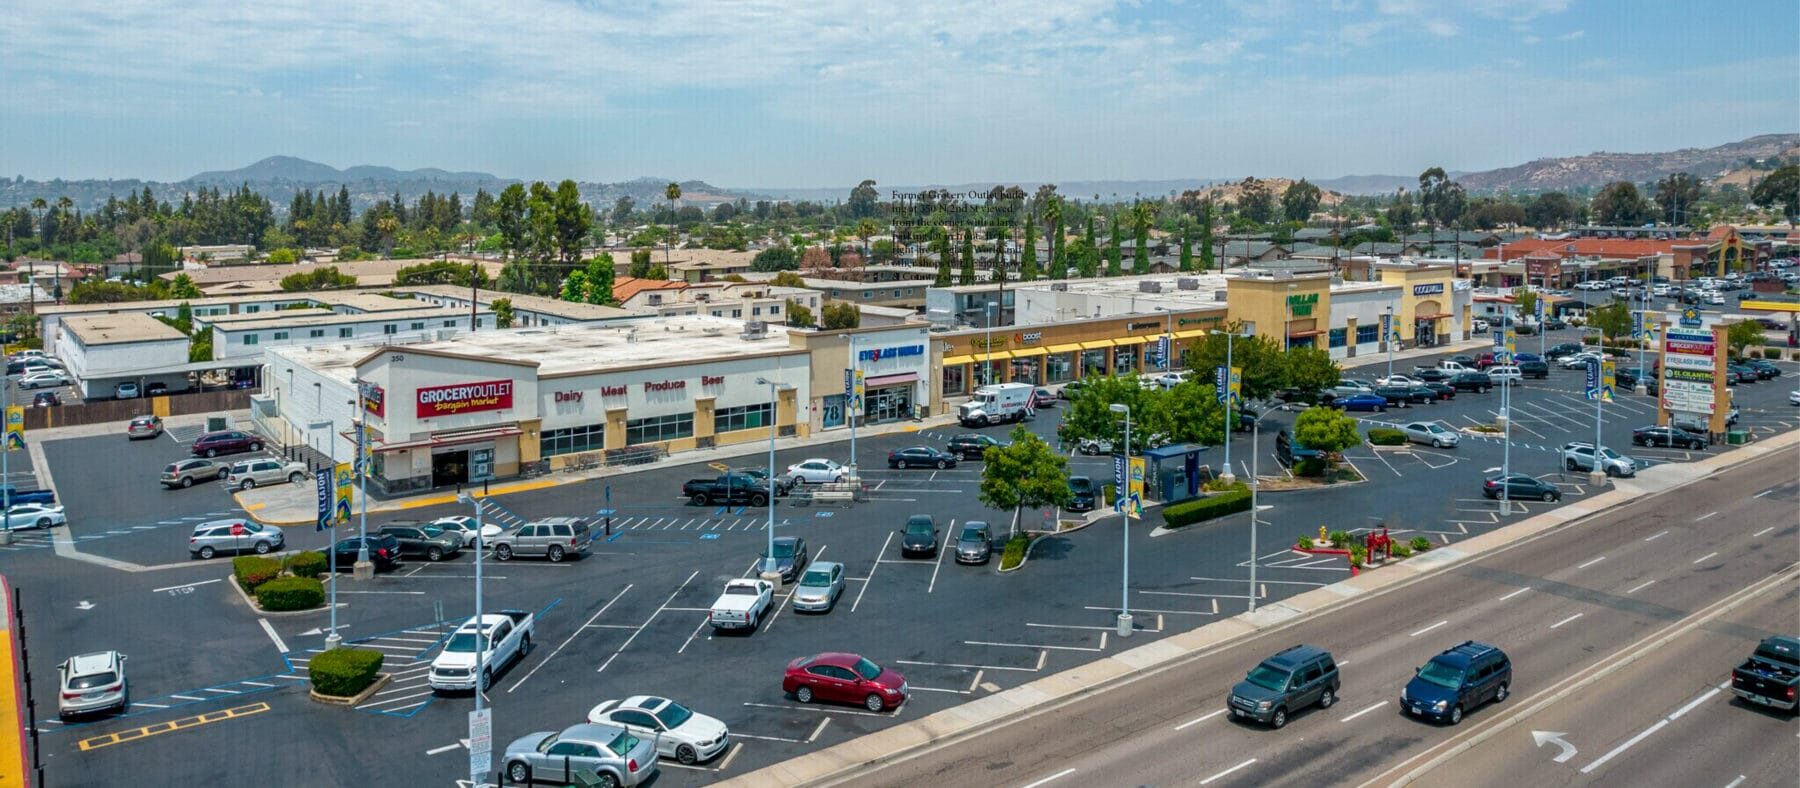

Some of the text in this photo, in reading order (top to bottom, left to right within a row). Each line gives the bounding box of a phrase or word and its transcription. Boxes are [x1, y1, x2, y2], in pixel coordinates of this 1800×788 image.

[1286, 293, 1319, 306] DOLLAR
[1022, 330, 1041, 340] boost
[859, 345, 924, 361] EYEGLASS WORLD
[554, 375, 724, 403] Dairy Meat Produce Beer
[434, 397, 499, 413] bargain market
[317, 473, 326, 500] CAJON
[1116, 485, 1121, 495] EL
[168, 587, 194, 596] STOP
